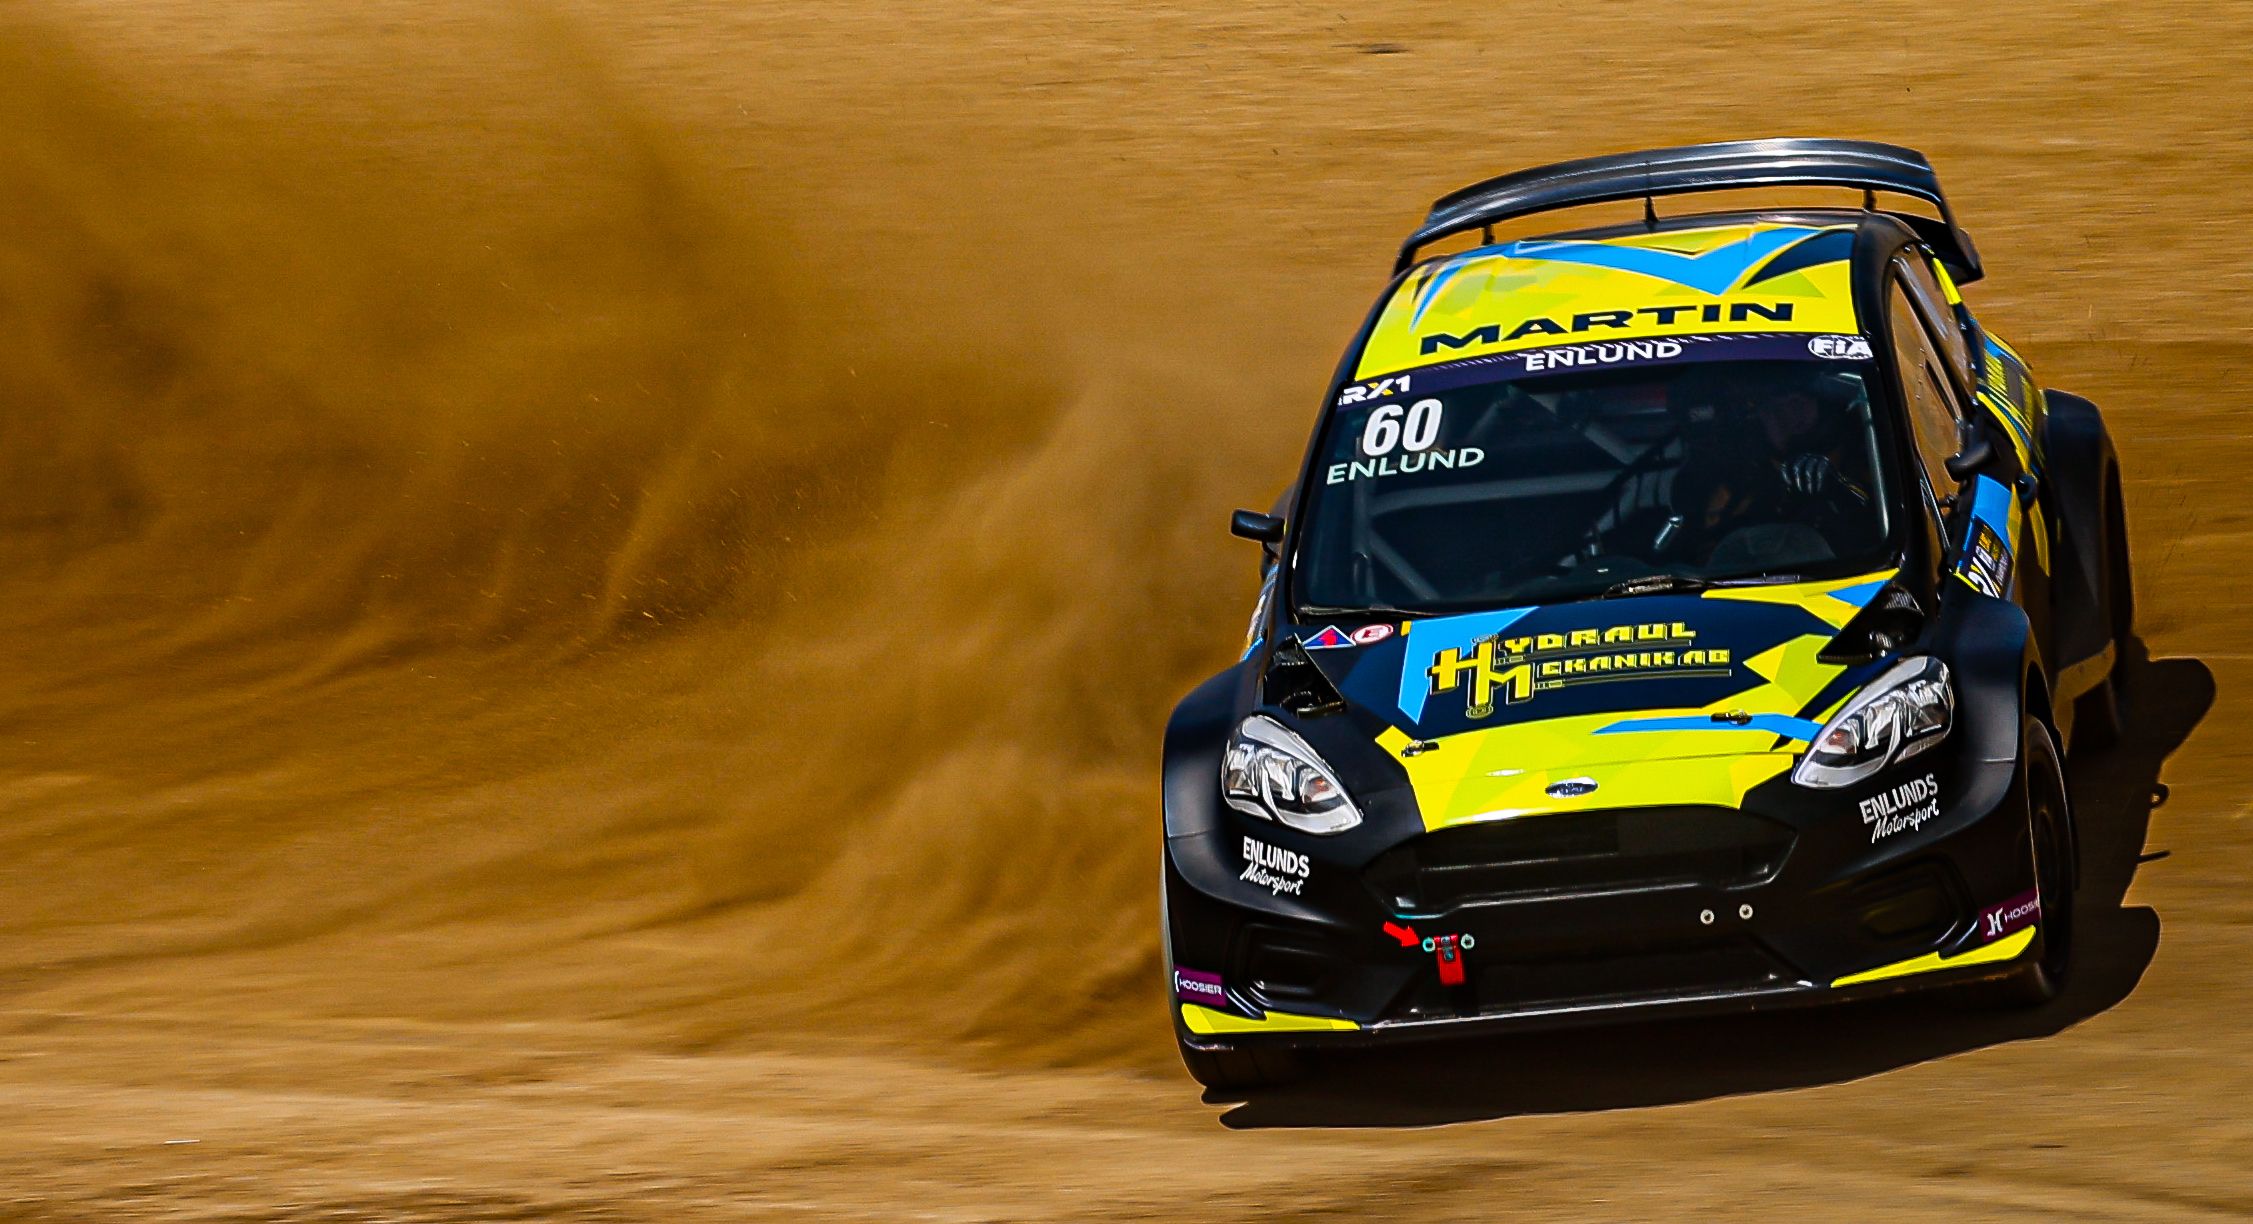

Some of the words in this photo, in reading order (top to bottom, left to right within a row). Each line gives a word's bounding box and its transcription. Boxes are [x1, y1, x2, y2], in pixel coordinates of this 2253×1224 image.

[1420, 303, 1793, 355] MARTIN
[1812, 338, 1873, 357] FIA
[1525, 342, 1683, 372] ENLUND
[1362, 398, 1443, 456] 60
[1326, 447, 1485, 485] ENLUND
[1425, 622, 1696, 716] HYDRAUL
[1859, 773, 1938, 825] ENLUNDS
[1871, 797, 1940, 844] Motorsport
[1240, 861, 1304, 896] Motorsport
[1243, 835, 1310, 878] ENLUNDS
